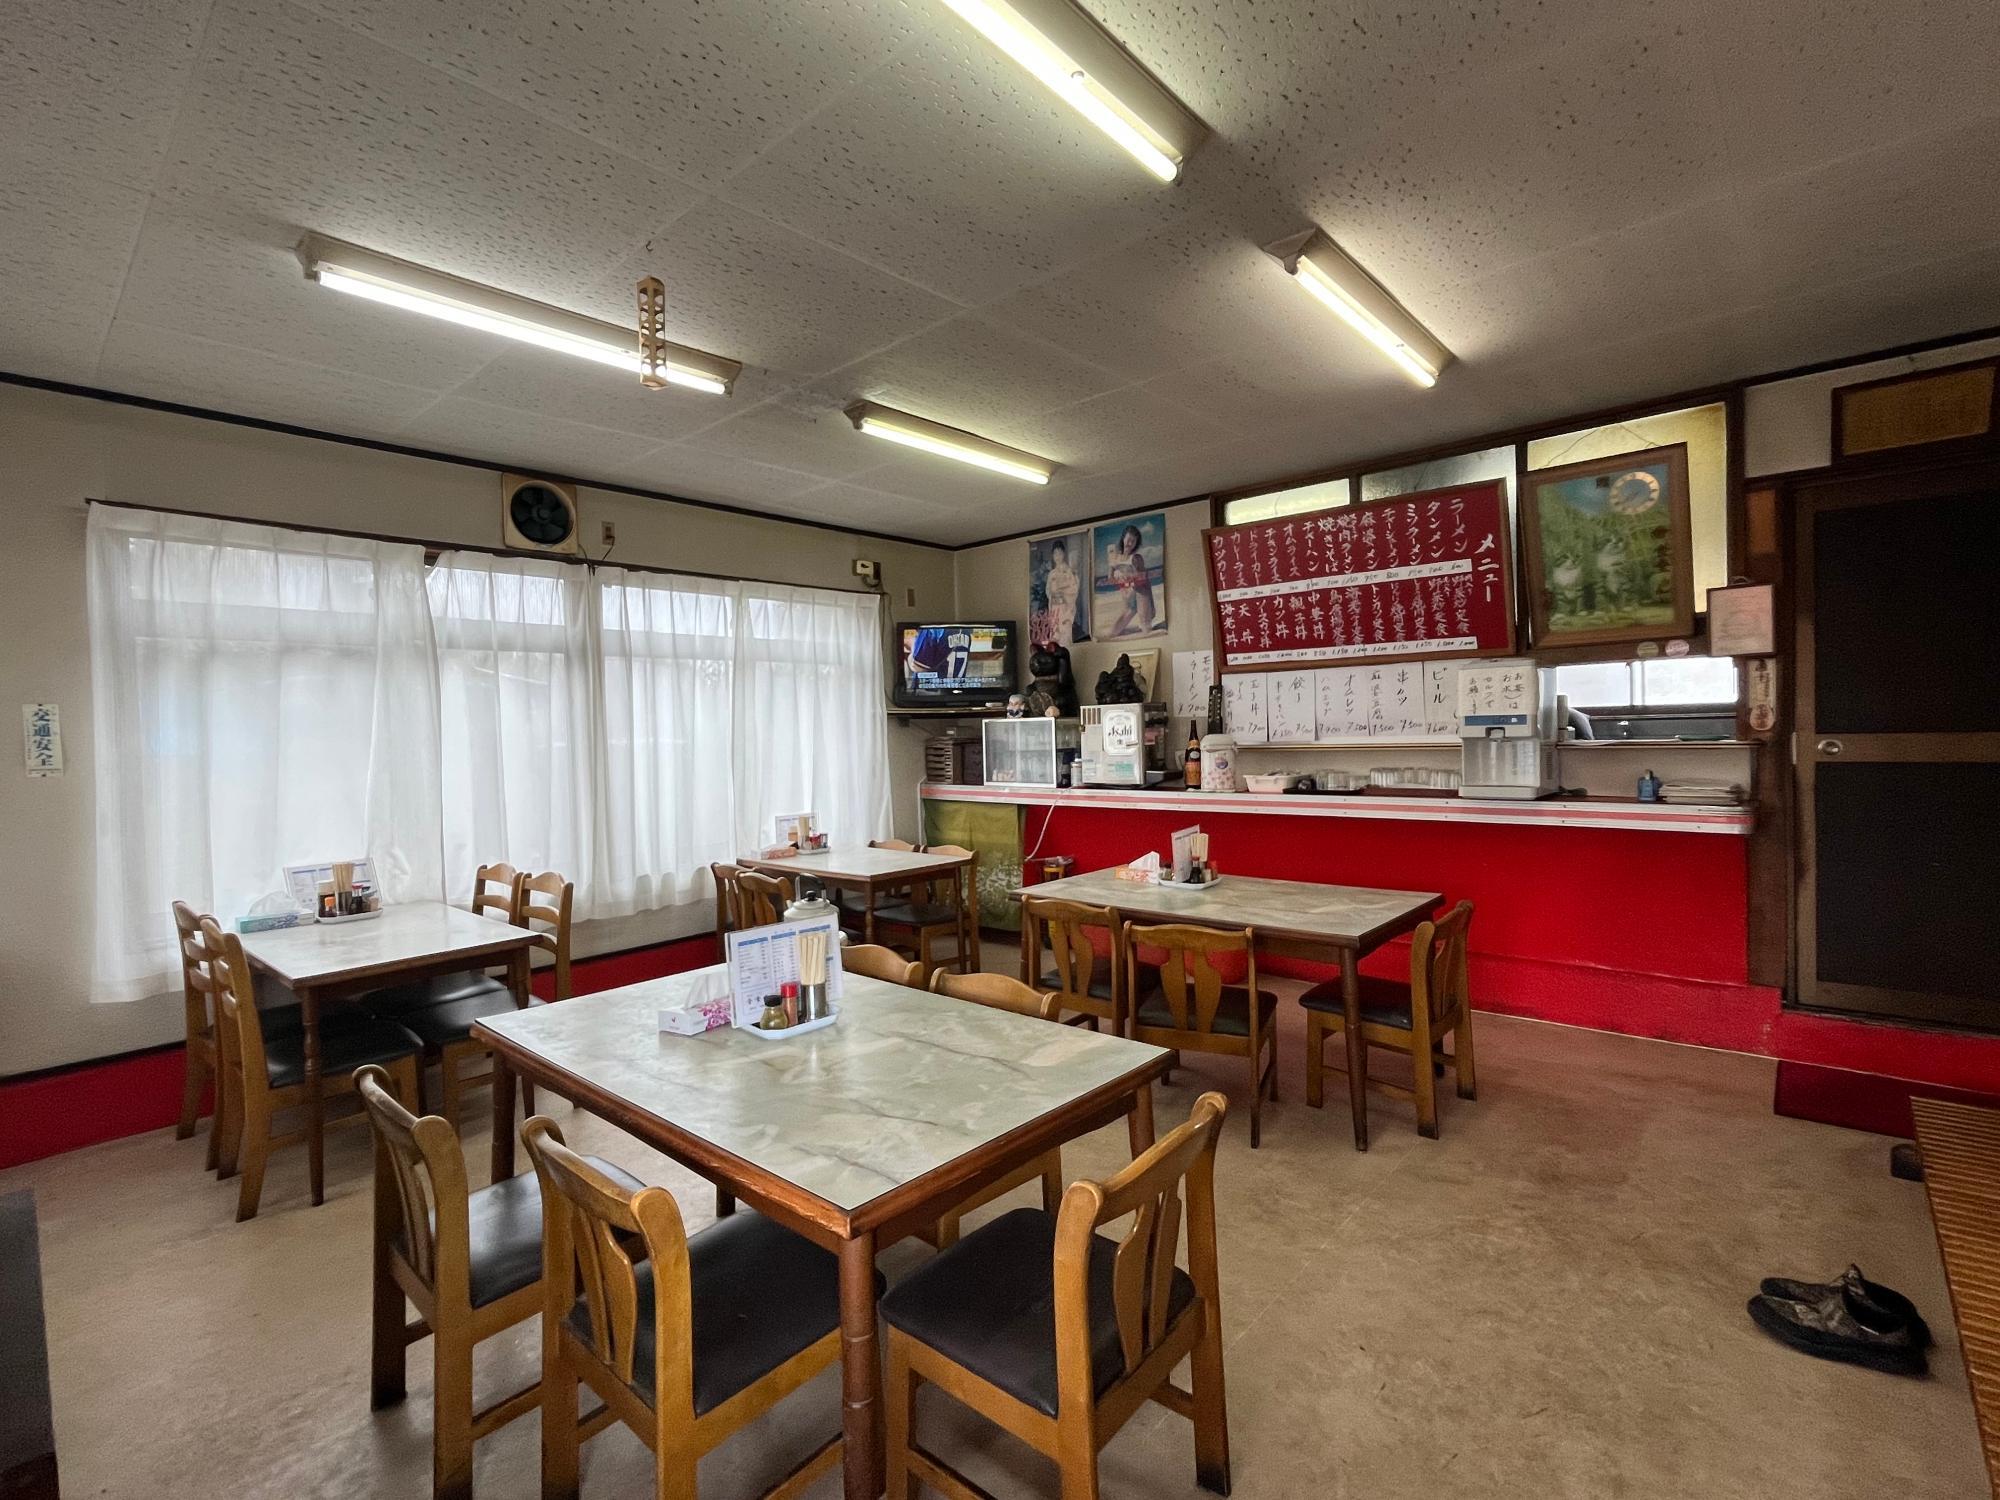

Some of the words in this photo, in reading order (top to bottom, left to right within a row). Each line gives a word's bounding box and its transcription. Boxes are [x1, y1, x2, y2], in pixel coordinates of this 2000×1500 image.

[1283, 522, 1300, 577] オムライス
[1302, 521, 1319, 572] チャーハン
[1318, 516, 1338, 574] 焼きそば
[1405, 503, 1424, 566] ミソラーメン
[1426, 501, 1446, 558] タンメン
[1449, 498, 1468, 553] ラーメン
[1213, 535, 1226, 590] カツカレー
[1231, 531, 1248, 587] カレーライス
[1248, 529, 1261, 586] ドライカレー
[1265, 528, 1282, 583] チキンライス
[1474, 532, 1500, 602] メニュー
[1238, 603, 1254, 644] 天丼
[1256, 599, 1272, 648] ソースカツ丼
[1273, 595, 1289, 639] カツ丼
[1289, 596, 1307, 640] 親子丼
[1308, 591, 1325, 640] 中華丼
[947, 651, 968, 678] 17
[1188, 659, 1199, 700] ラーメン
[1432, 667, 1448, 704] ビール
[1344, 673, 1356, 715] オムレツ
[32, 708, 53, 767] 交通安全
[1108, 725, 1132, 736] Asahi
